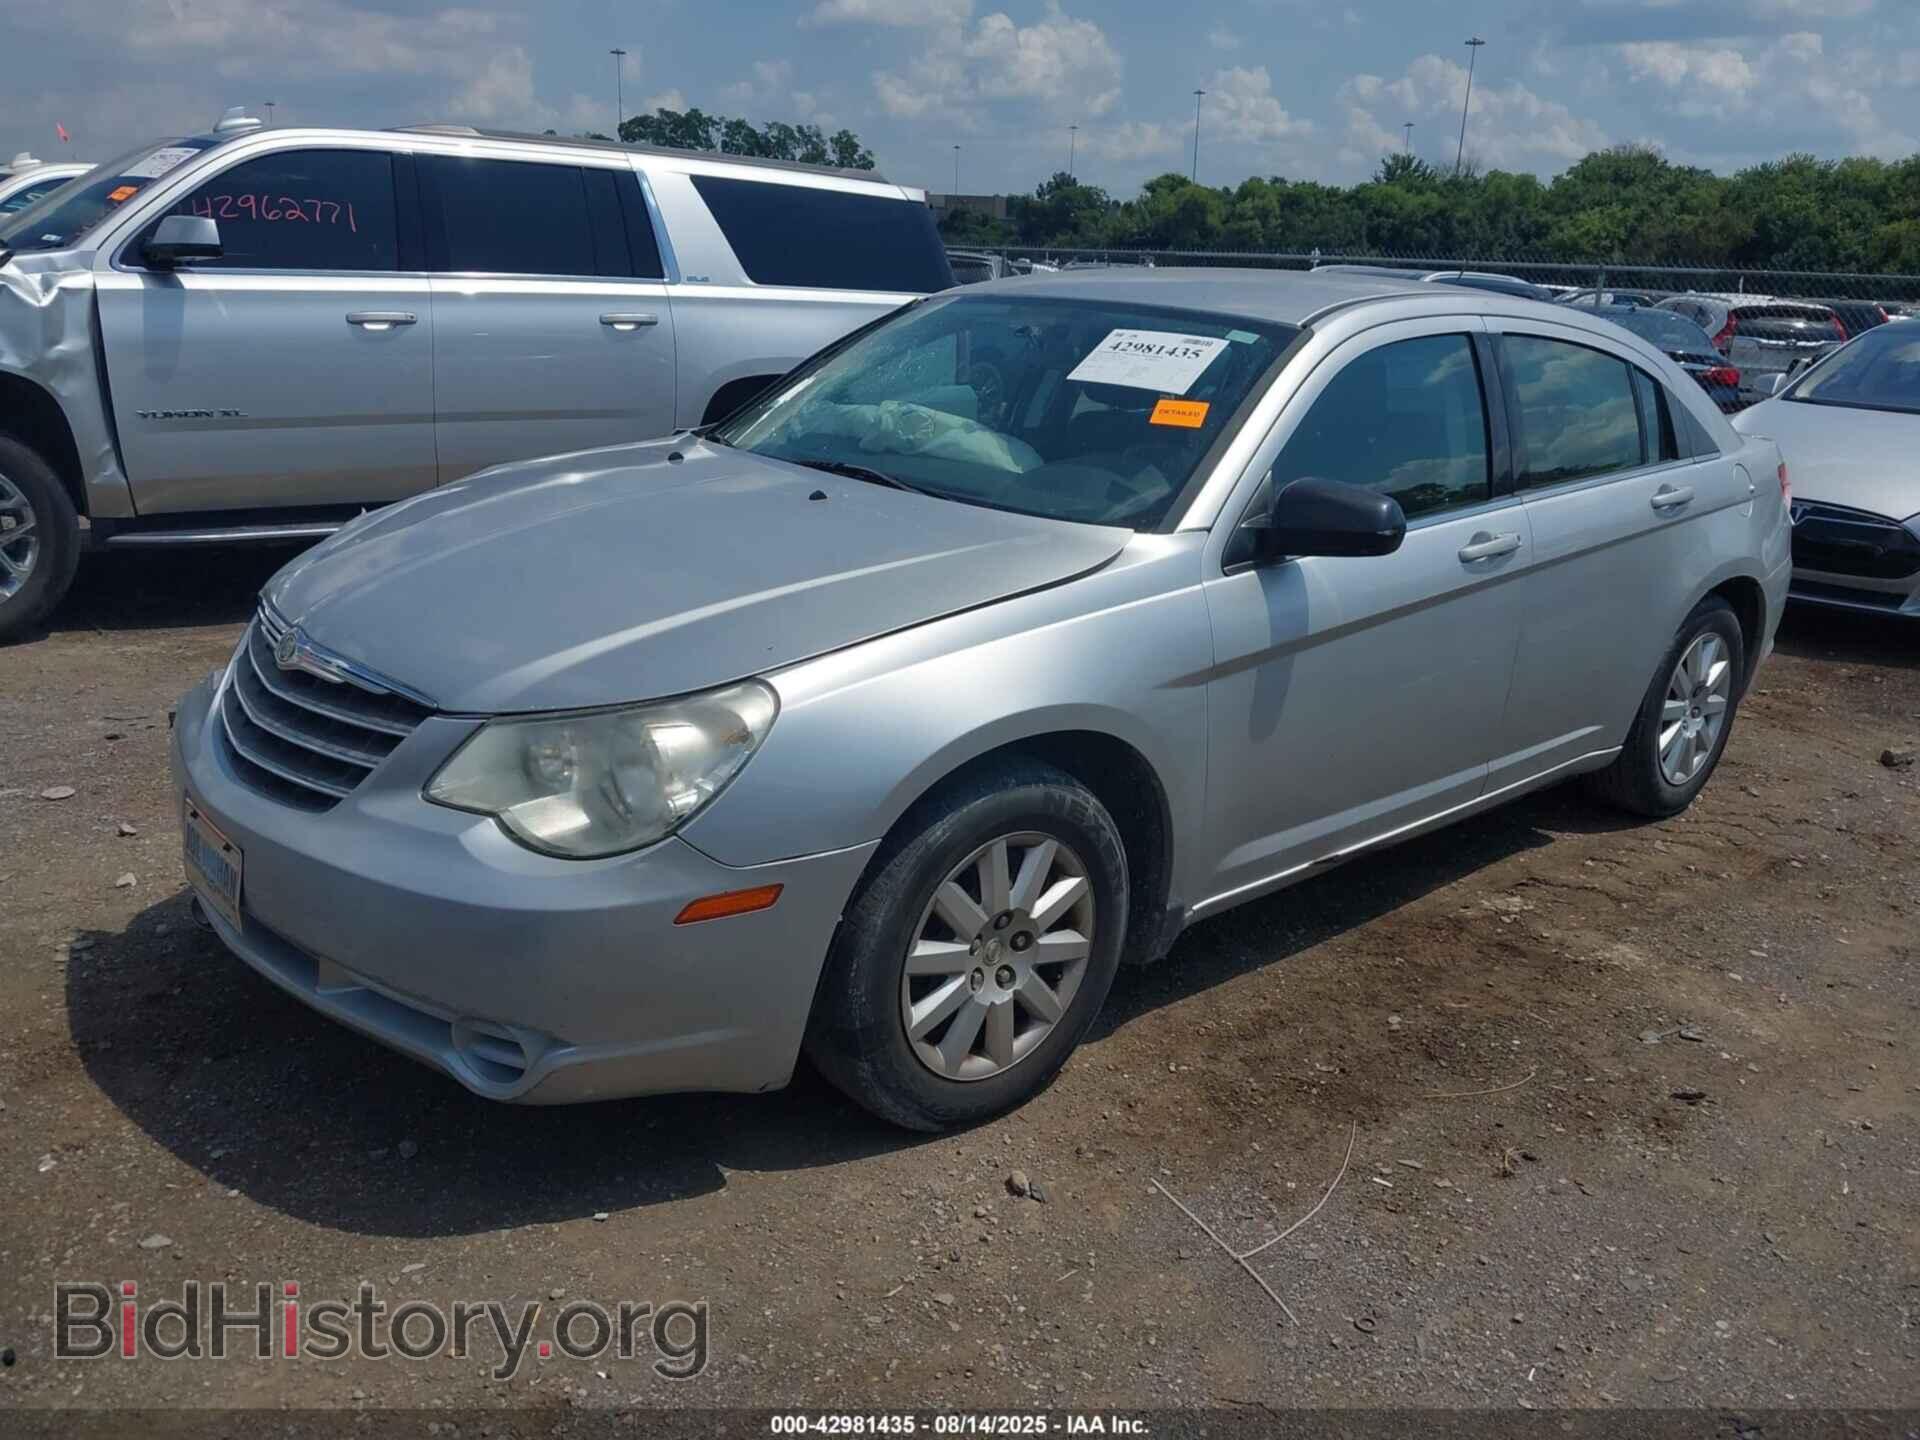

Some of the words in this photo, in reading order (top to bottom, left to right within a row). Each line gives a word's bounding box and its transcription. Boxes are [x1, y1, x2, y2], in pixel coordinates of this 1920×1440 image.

[192, 194, 357, 232] 42962771
[1109, 341, 1203, 360] 42981435
[136, 408, 214, 420] YUKON
